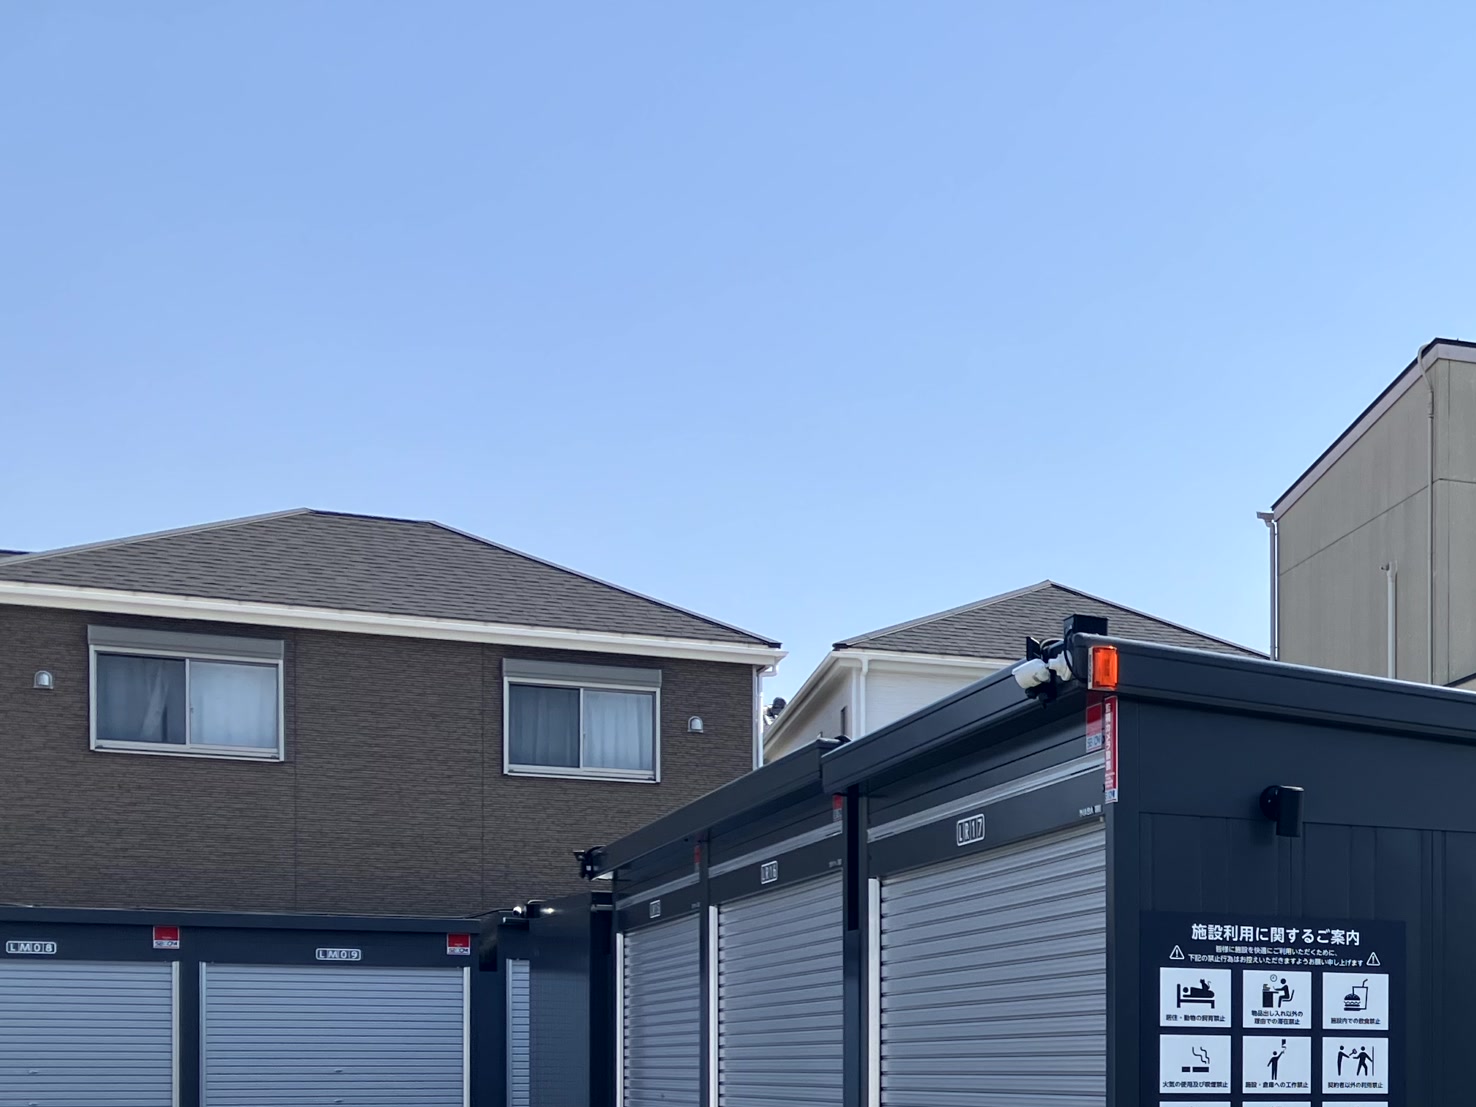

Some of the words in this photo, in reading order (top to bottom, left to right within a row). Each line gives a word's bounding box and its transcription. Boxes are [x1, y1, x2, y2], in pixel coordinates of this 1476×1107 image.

[958, 819, 983, 842] LR17
[1191, 923, 1360, 946] 施設利用に関するご案内
[9, 942, 53, 952] LM08
[319, 950, 358, 959] LM09
